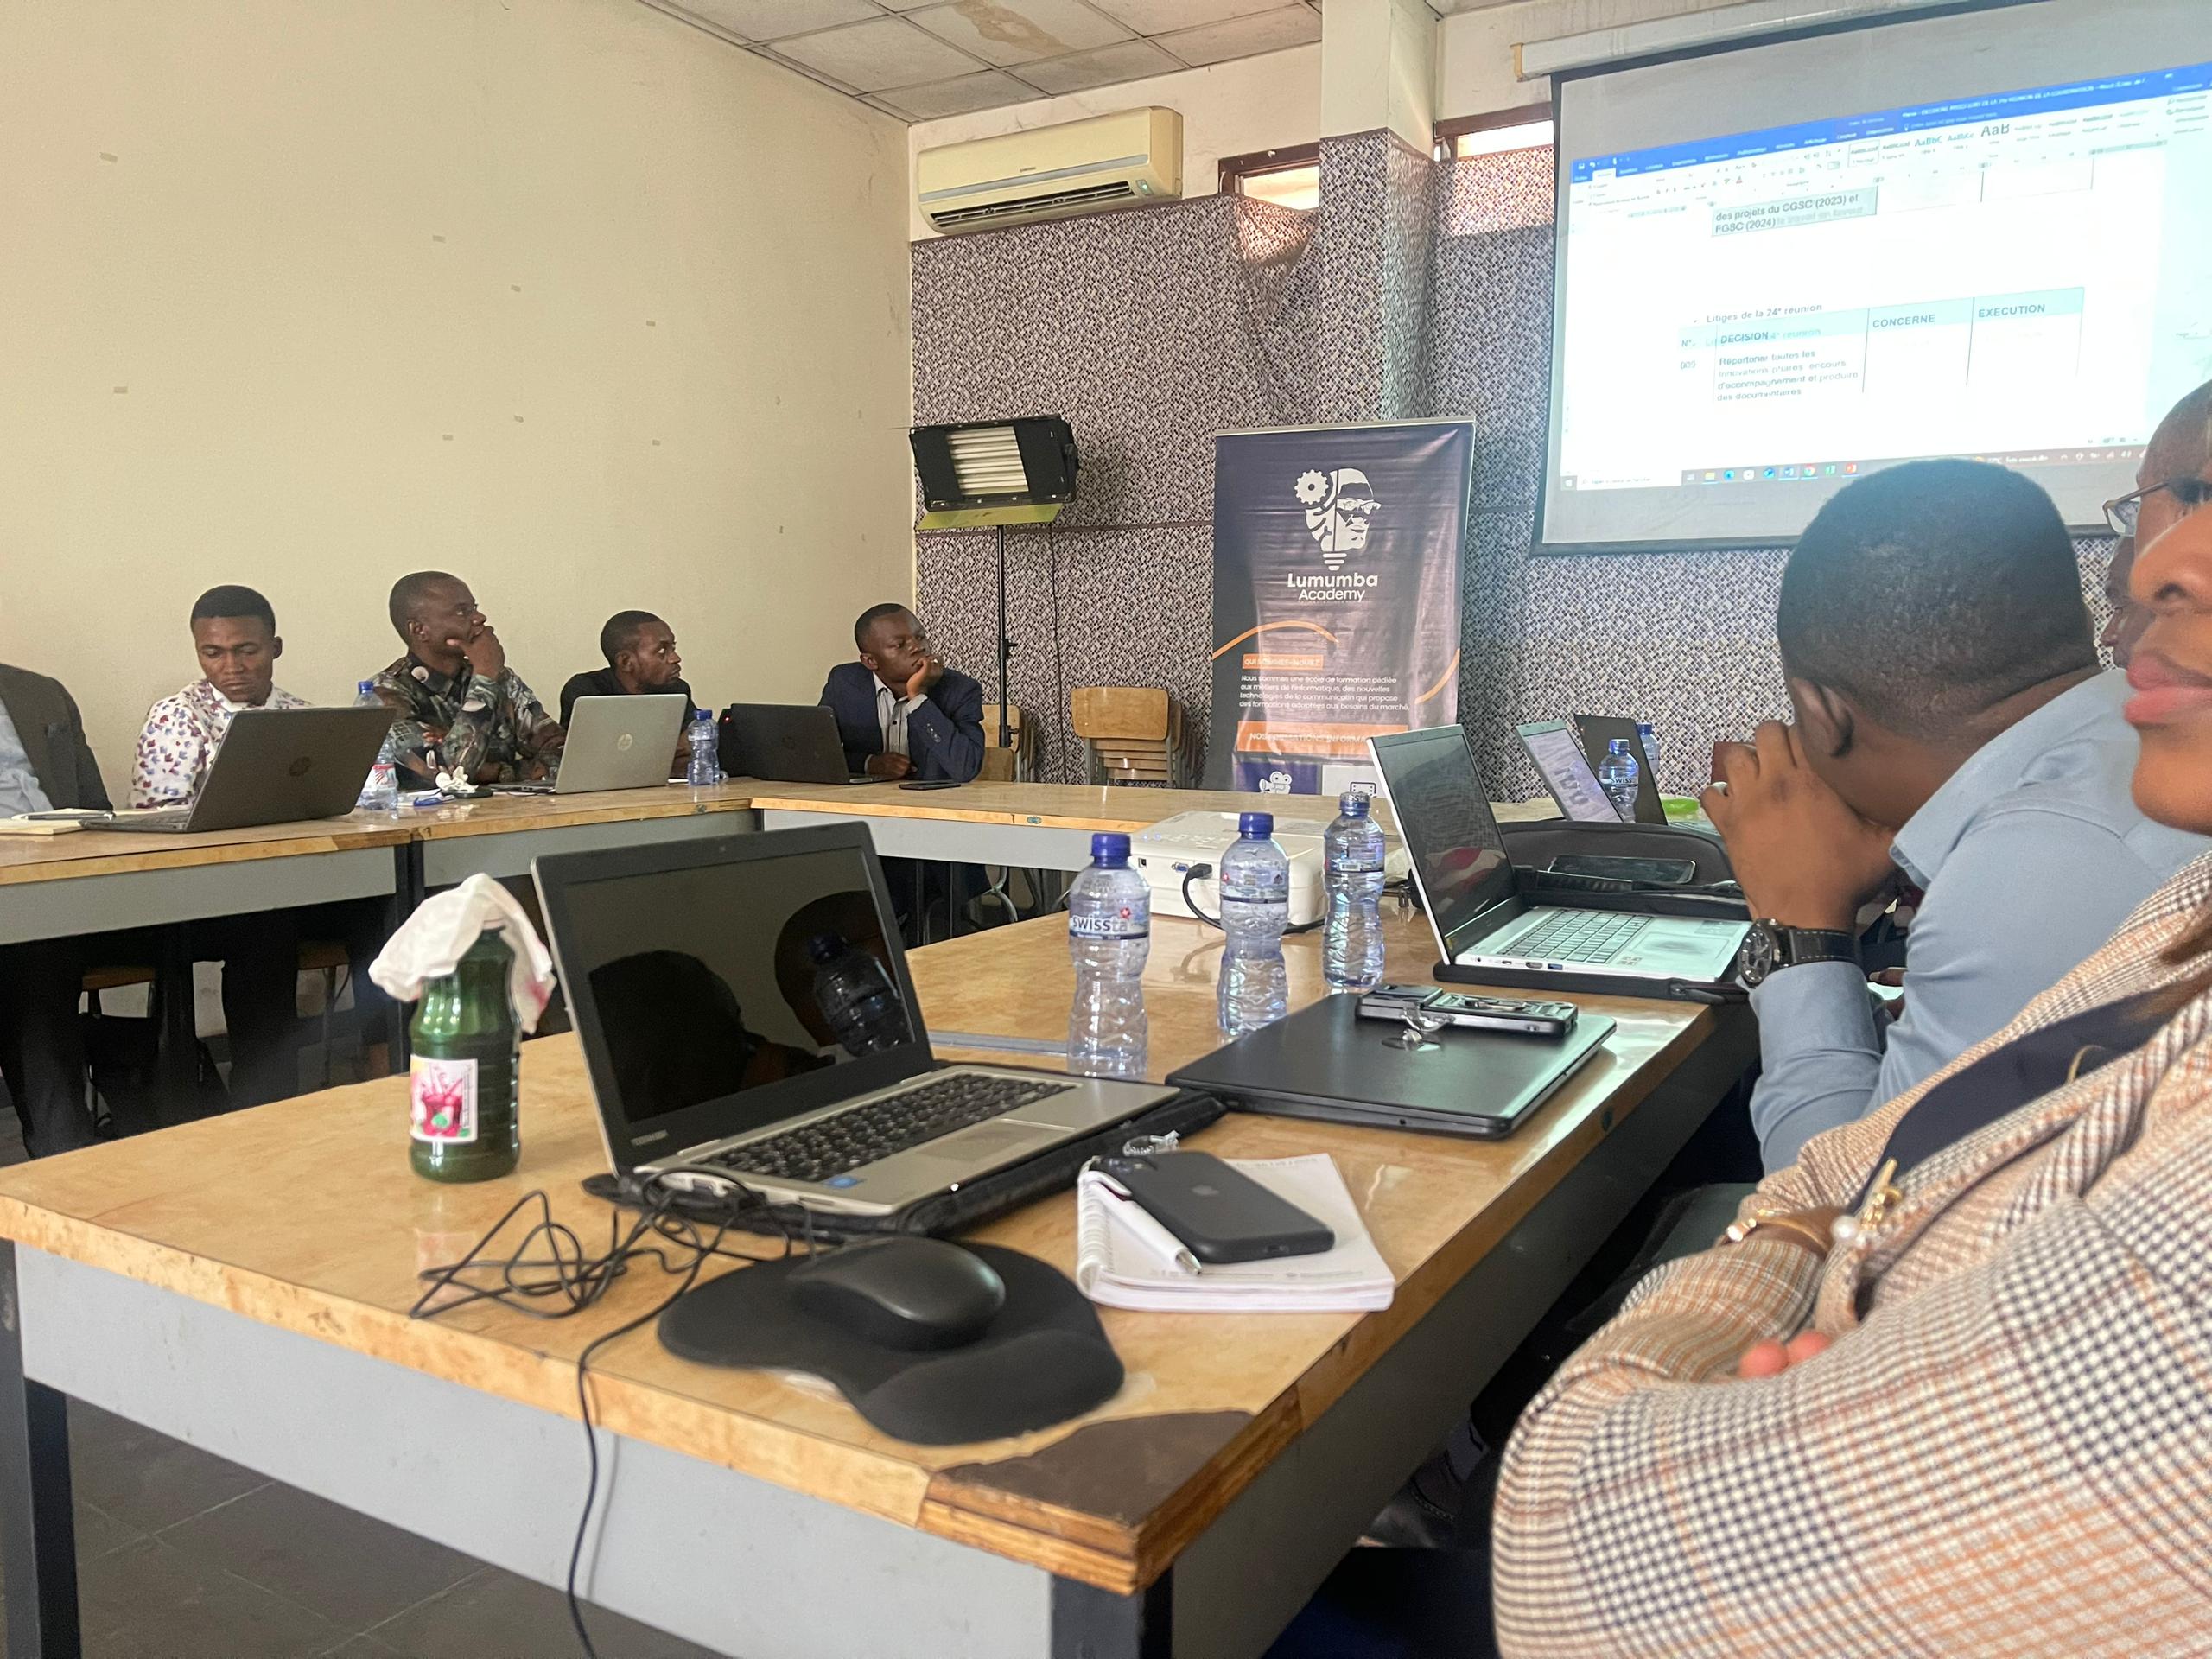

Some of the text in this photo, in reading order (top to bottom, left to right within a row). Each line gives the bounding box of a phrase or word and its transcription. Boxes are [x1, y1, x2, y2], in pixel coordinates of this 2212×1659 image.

[1715, 210, 1732, 222] des
[1734, 207, 1766, 220] projets
[1767, 205, 1781, 214] du
[1782, 199, 1814, 213] CGSC
[1815, 194, 1847, 211] (2023)
[1848, 194, 1859, 203] et
[1714, 221, 1745, 234] FGSC
[1745, 217, 1777, 232] (2024)
[1740, 310, 1753, 320] de
[1755, 309, 1764, 318] la
[1978, 303, 2046, 318] EXECUTION
[1872, 314, 1936, 328] CONCERNE
[1719, 331, 1770, 345] DECISION
[1802, 350, 1816, 359] les
[1807, 374, 1818, 383] et
[1716, 393, 1733, 403] des
[1287, 572, 1379, 588] Lumumba
[1298, 588, 1366, 602] Academy
[1239, 692, 1284, 701] technologies
[1355, 695, 1368, 703] qui
[1368, 695, 1399, 703] propose
[1072, 914, 1128, 932] swissta
